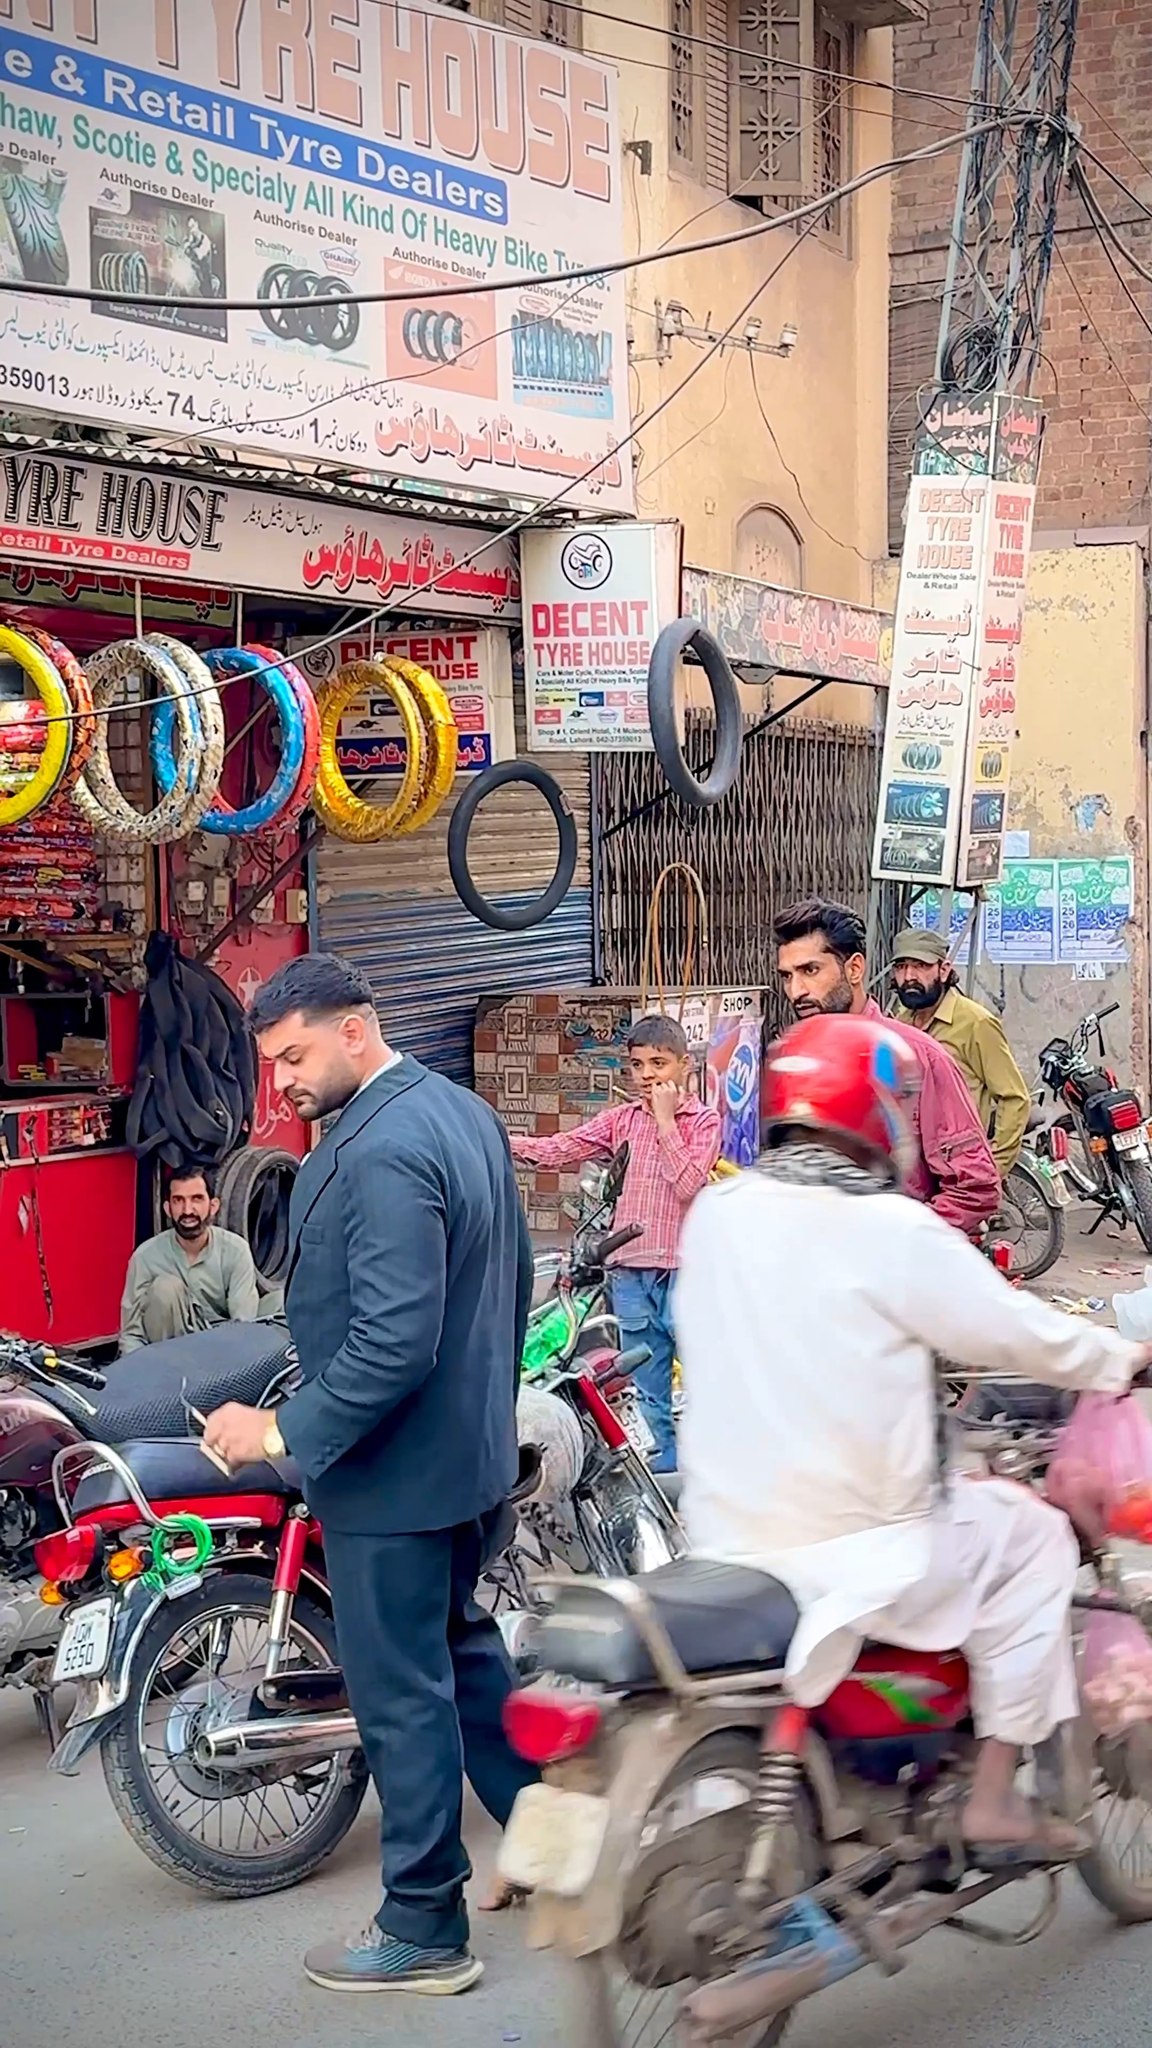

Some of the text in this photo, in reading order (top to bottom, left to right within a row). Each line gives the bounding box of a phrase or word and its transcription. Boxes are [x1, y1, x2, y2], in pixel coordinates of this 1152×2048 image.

[379, 2, 610, 203] HOUSE
[50, 54, 87, 96] &
[104, 69, 235, 140] Retail
[249, 113, 343, 171] Tyre
[357, 146, 504, 217] Dealers
[9, 143, 57, 166] Dealer
[73, 114, 156, 168] Scotie
[165, 140, 184, 177] &
[192, 148, 297, 214] Specialy
[303, 180, 334, 218] All
[342, 190, 394, 235] Kind
[402, 208, 428, 243] Of
[433, 215, 498, 268] Heavy
[504, 236, 548, 274] Bike
[99, 168, 215, 209] Authorise Dealer
[253, 209, 358, 247] Authorise Dealer
[392, 246, 449, 270] Authorise
[451, 262, 488, 280] Dealer
[571, 291, 604, 311] Dealer
[166, 391, 196, 421] 74
[96, 471, 229, 552] HOUSE
[919, 488, 985, 513] DECENT
[927, 516, 972, 541] TYRE
[0, 531, 188, 569] etail Tyre Dealers
[917, 544, 973, 570] HOUSE
[931, 582, 958, 590] Retail
[532, 601, 648, 638] DECENT
[533, 641, 650, 667] TYRE HOUSE
[1061, 893, 1074, 903] 24
[912, 907, 924, 918] 25
[987, 907, 999, 917] 25
[1061, 906, 1074, 916] 25
[987, 920, 999, 930] 26
[1061, 919, 1074, 929] 26
[723, 997, 753, 1012] SHOP
[686, 1023, 704, 1043] 242
